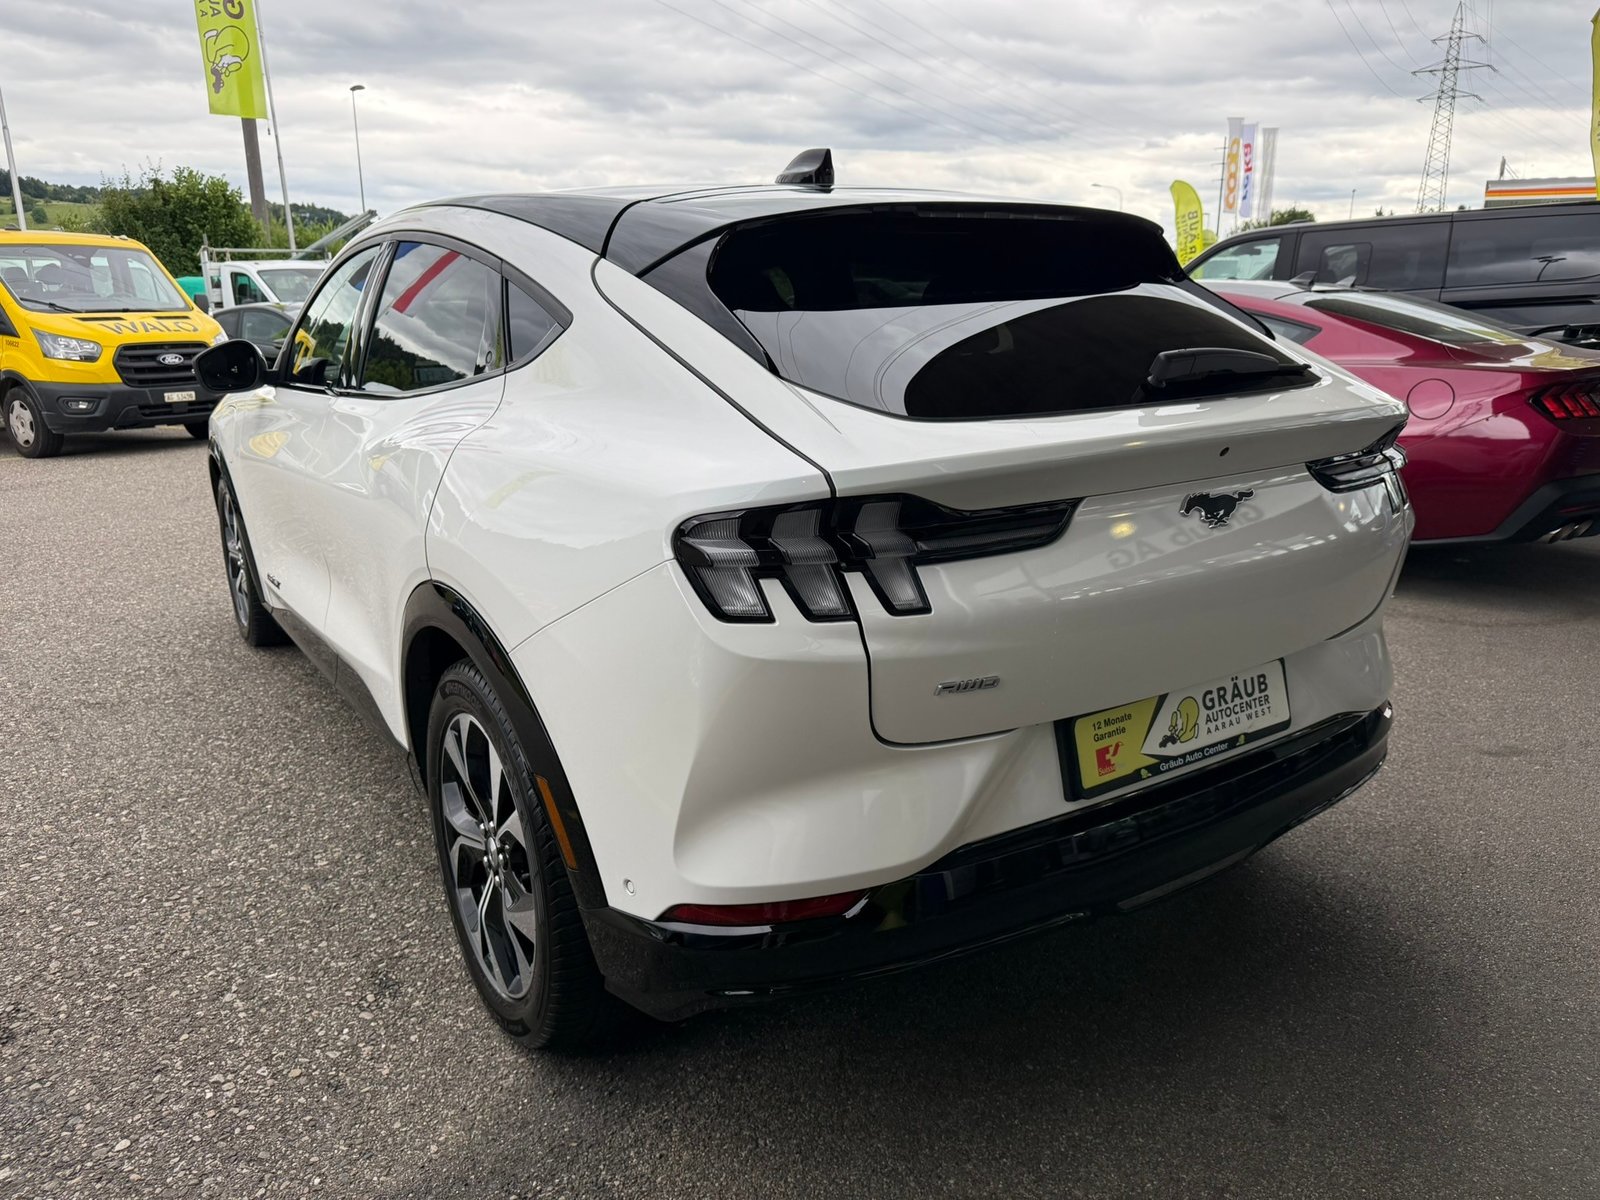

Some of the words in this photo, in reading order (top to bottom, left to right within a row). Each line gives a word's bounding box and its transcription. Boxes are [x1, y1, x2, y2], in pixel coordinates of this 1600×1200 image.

[99, 321, 198, 334] WALO
[1202, 673, 1268, 711] GRÄUB
[1092, 721, 1102, 731] 12
[1104, 713, 1132, 728] Monate
[1205, 694, 1270, 725] AUTOCENTER
[1206, 716, 1241, 735] AARAU
[1246, 706, 1272, 721] WEST
[1093, 726, 1126, 743] Garantie
[1160, 757, 1184, 771] Gräub
[1185, 751, 1203, 763] Auto
[1203, 743, 1229, 756] Center
